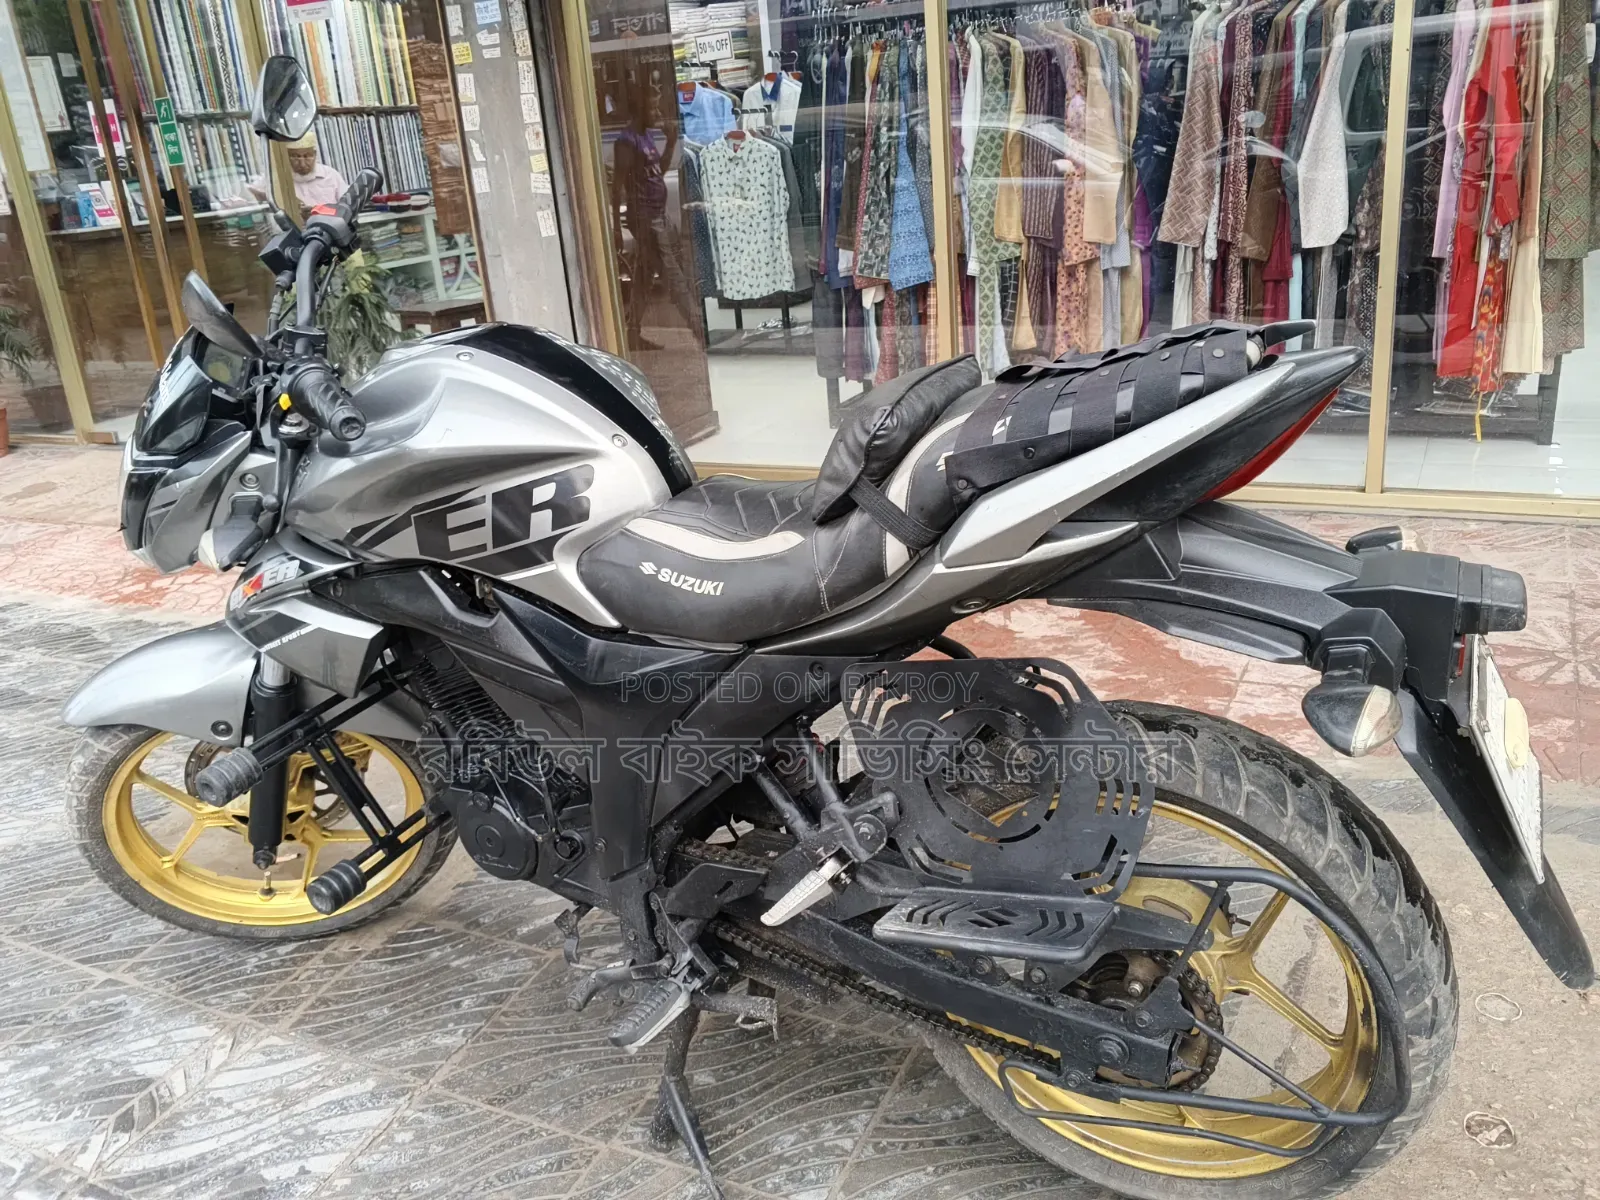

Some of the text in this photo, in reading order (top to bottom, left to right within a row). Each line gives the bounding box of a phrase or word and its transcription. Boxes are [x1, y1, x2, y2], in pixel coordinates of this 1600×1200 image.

[698, 38, 729, 54] 50 % OFF
[658, 567, 724, 596] SUZUKI
